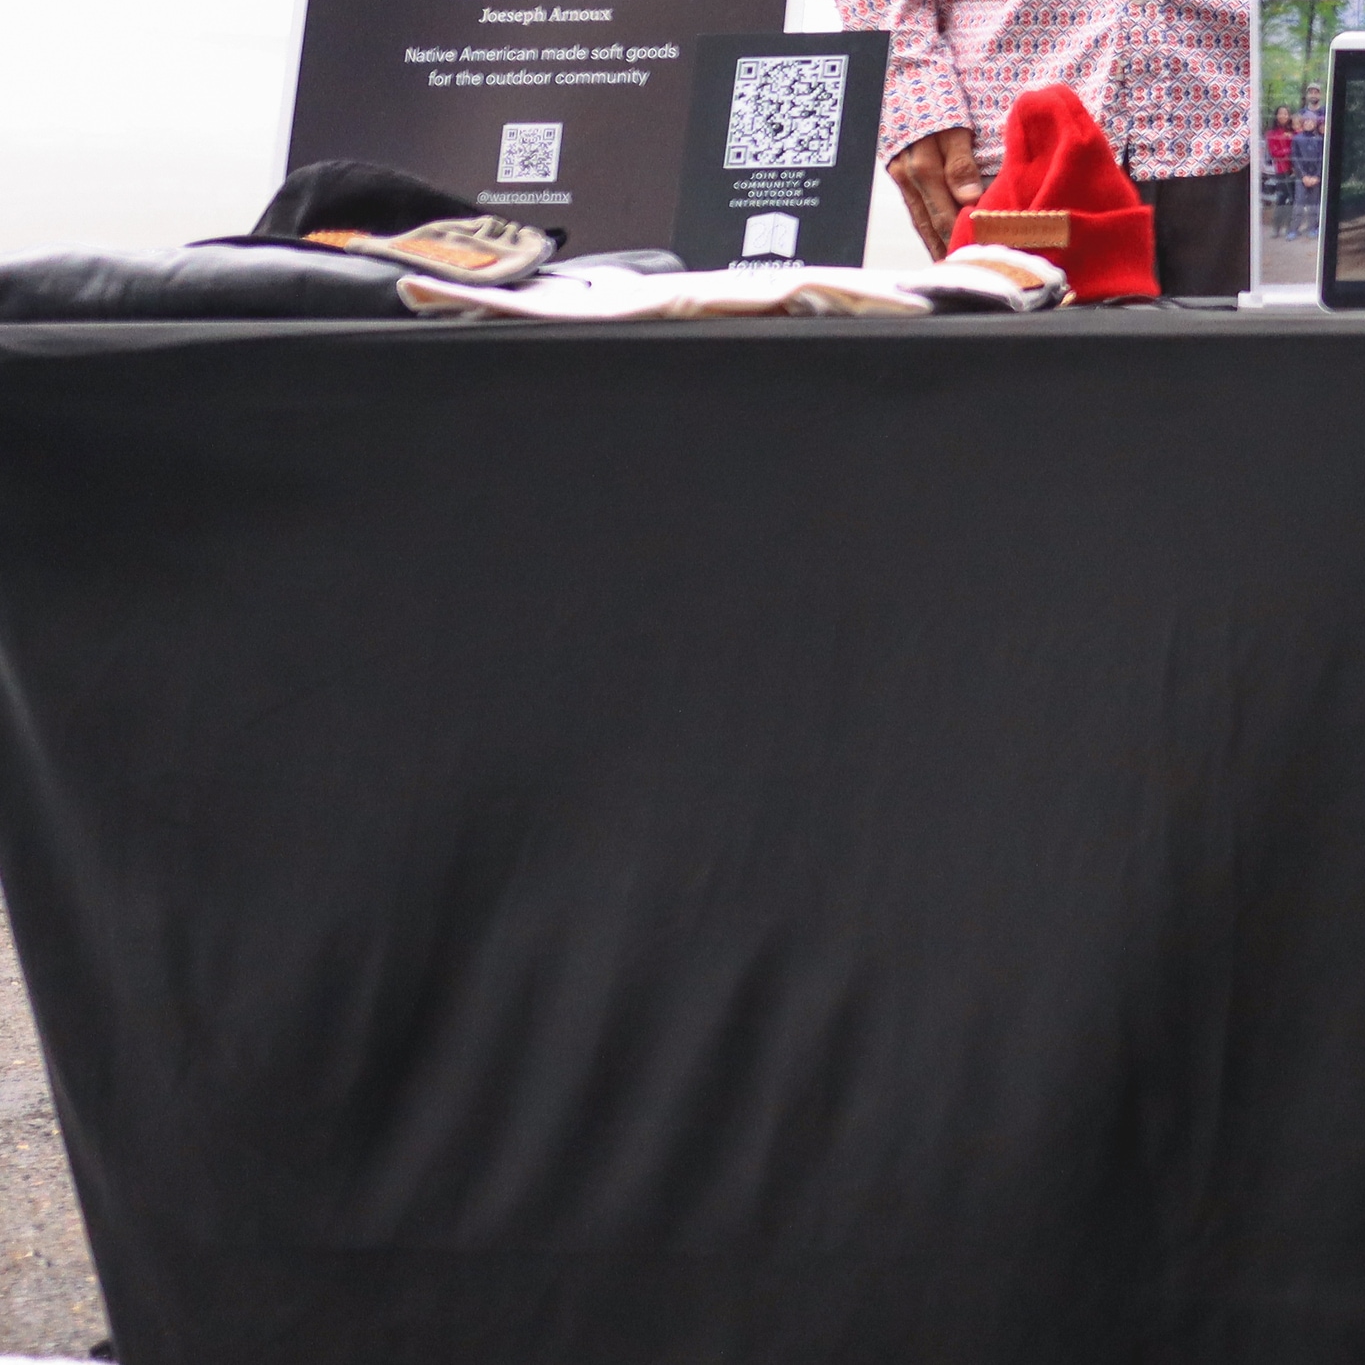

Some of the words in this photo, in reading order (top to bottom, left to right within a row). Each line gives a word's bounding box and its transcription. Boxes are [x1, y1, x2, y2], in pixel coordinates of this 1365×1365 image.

[478, 6, 547, 25] Joeseph
[548, 6, 613, 23] Arnoux
[404, 46, 455, 63] Native
[458, 44, 538, 62] American
[540, 44, 587, 61] made
[590, 42, 624, 61] soft
[625, 42, 680, 63] goods
[428, 69, 452, 86] for
[455, 69, 482, 86] the
[485, 68, 553, 86] outdoor
[555, 67, 651, 87] community
[750, 170, 777, 180] JOIN
[779, 170, 806, 179] OUR
[733, 179, 802, 190] COMMUNITY
[803, 178, 821, 188] OF
[747, 188, 804, 198] OUTDOOR
[728, 196, 820, 208] ENTREPRENEURS
